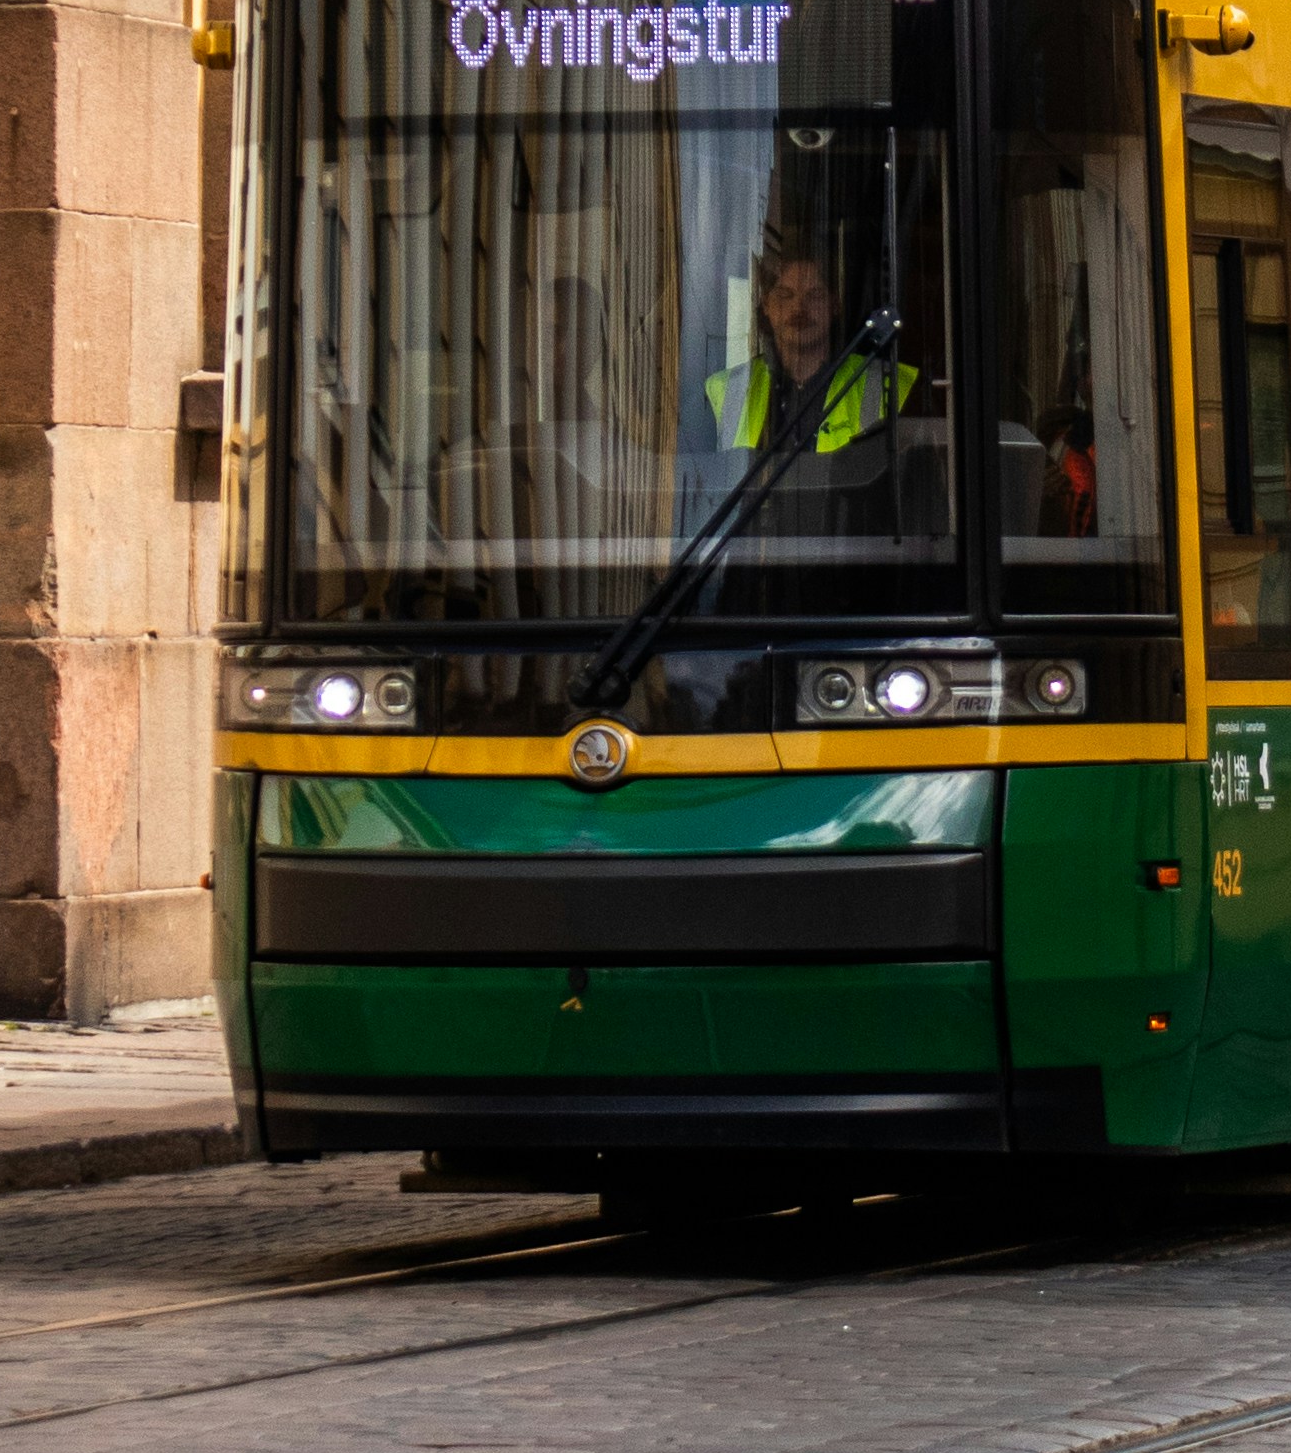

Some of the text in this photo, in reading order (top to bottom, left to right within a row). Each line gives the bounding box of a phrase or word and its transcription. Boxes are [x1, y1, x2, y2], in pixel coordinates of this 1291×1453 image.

[1234, 754, 1250, 778] HSL
[1234, 778, 1250, 802] HRT
[1213, 849, 1242, 897] 452
